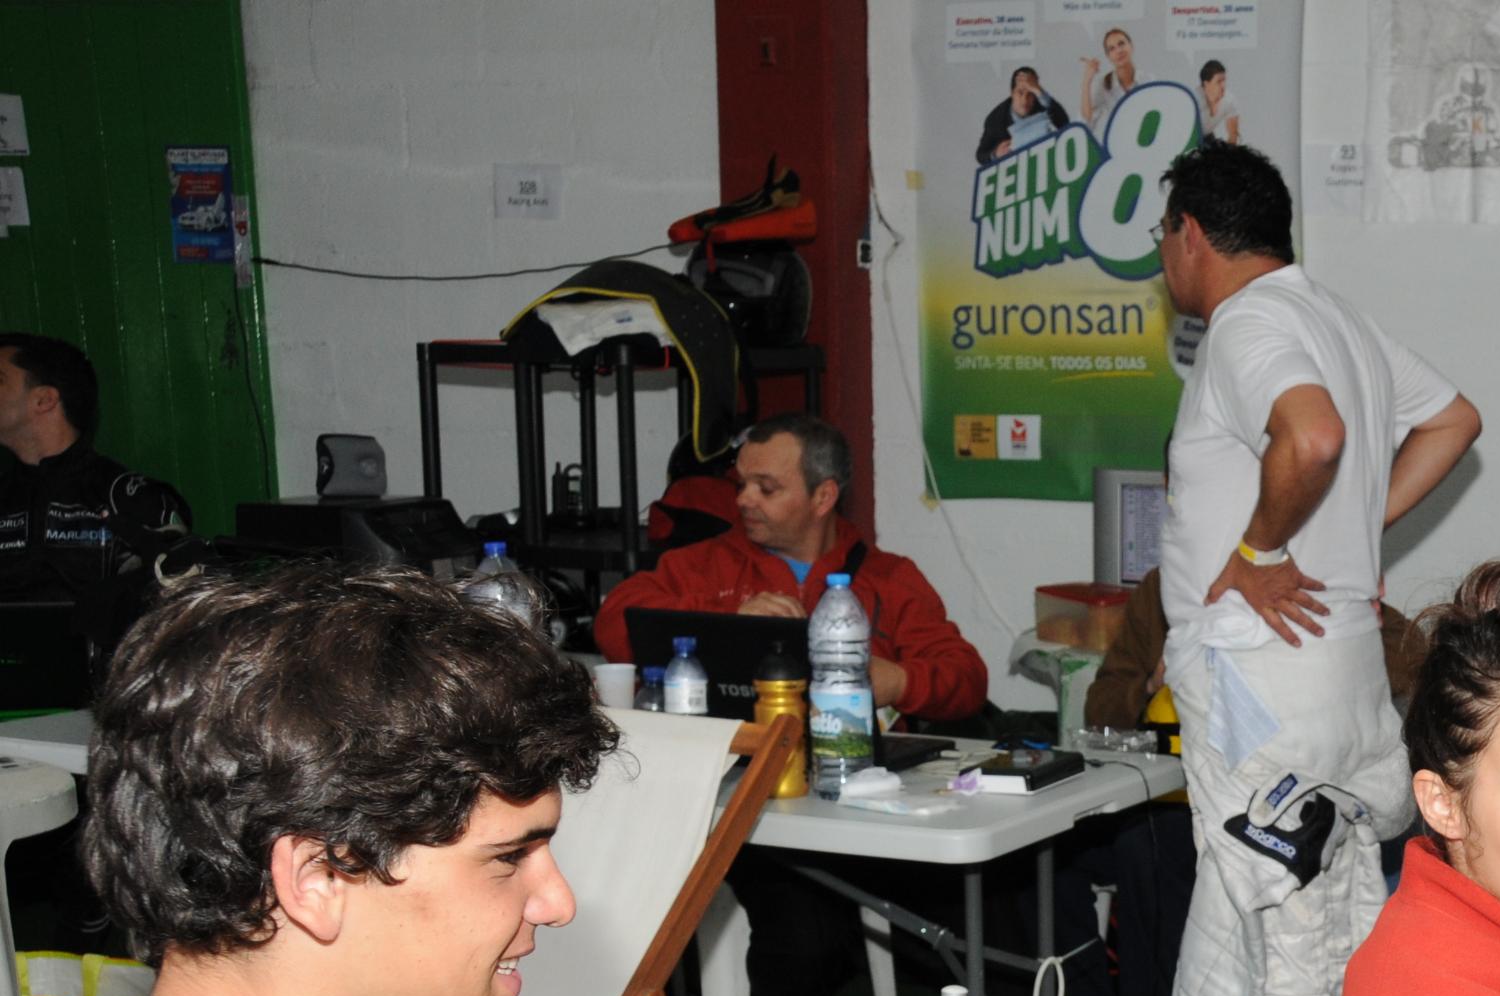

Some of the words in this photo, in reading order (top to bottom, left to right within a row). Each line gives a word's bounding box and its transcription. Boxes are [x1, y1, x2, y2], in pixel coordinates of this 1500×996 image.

[975, 130, 1089, 218] FEITO
[1079, 80, 1200, 262] 8
[978, 188, 1070, 266] NUM
[952, 303, 1144, 350] guronsan
[1050, 356, 1092, 370] TODOS
[1095, 356, 1112, 370] OS
[1114, 356, 1147, 370] DIAS
